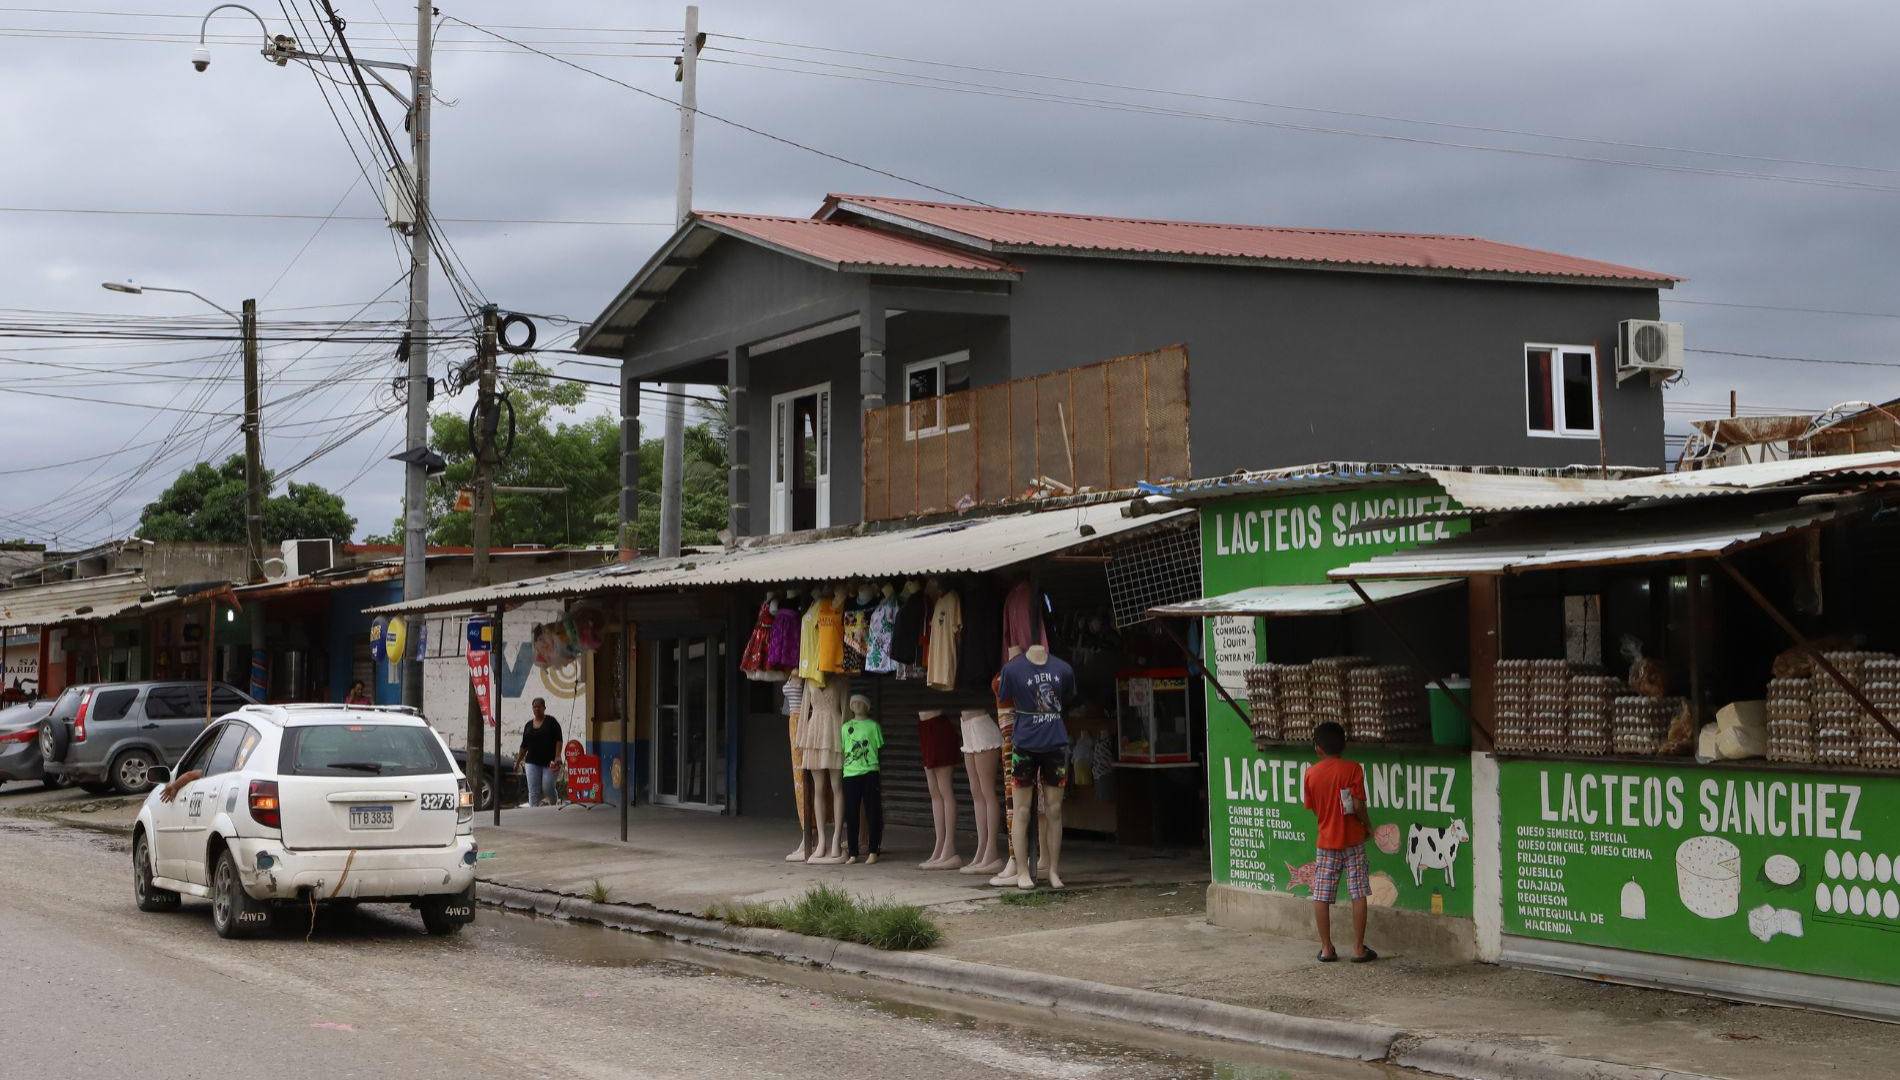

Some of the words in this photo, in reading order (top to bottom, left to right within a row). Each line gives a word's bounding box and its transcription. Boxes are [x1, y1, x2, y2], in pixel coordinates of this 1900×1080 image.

[1216, 505, 1321, 555] LACTEOS
[1332, 496, 1450, 547] SANCHEZ
[1215, 653, 1242, 663] CONTRA
[5, 666, 38, 674] ARBE
[1224, 757, 1312, 804] LACTEO
[1358, 762, 1456, 813] ANCHEZ
[421, 794, 454, 810] 3273
[1540, 771, 1684, 829] LACTEOS
[1699, 778, 1862, 841] SANCHEZ
[370, 811, 393, 824] 3833
[1228, 805, 1253, 816] CARNE
[1254, 807, 1264, 817] DE
[1265, 808, 1280, 818] RES
[1229, 816, 1253, 827] CARNE
[1254, 817, 1265, 827] DE
[1266, 819, 1292, 829] CERDO
[1229, 827, 1264, 838] CHULETA
[1273, 830, 1306, 841] FRIJOLES
[1517, 826, 1545, 837] QUESO
[1546, 828, 1587, 841] SEMISECO,
[1590, 831, 1628, 843] ESPECIAL
[1229, 838, 1265, 849] COSTILLA
[1517, 840, 1545, 850] QUESO
[1546, 841, 1562, 851] CON
[1563, 842, 1588, 855] CHILE,
[1590, 845, 1619, 857] QUESO
[1621, 847, 1653, 860] CREMA
[1230, 848, 1257, 859] POLLO
[1517, 852, 1567, 866] FRIJOLERO
[1230, 859, 1266, 870] PESCADO
[1230, 869, 1275, 883] EMBUTIDOS
[1518, 866, 1563, 879] QUESILLO
[1517, 879, 1565, 893] CUAJADA
[1517, 892, 1568, 906] REQUESON
[240, 911, 267, 922] 4WD
[445, 905, 470, 916] 4WD
[1518, 905, 1587, 923] MANTEQUILLA
[1590, 912, 1605, 925] DE
[1524, 919, 1573, 934] HACIENDA
